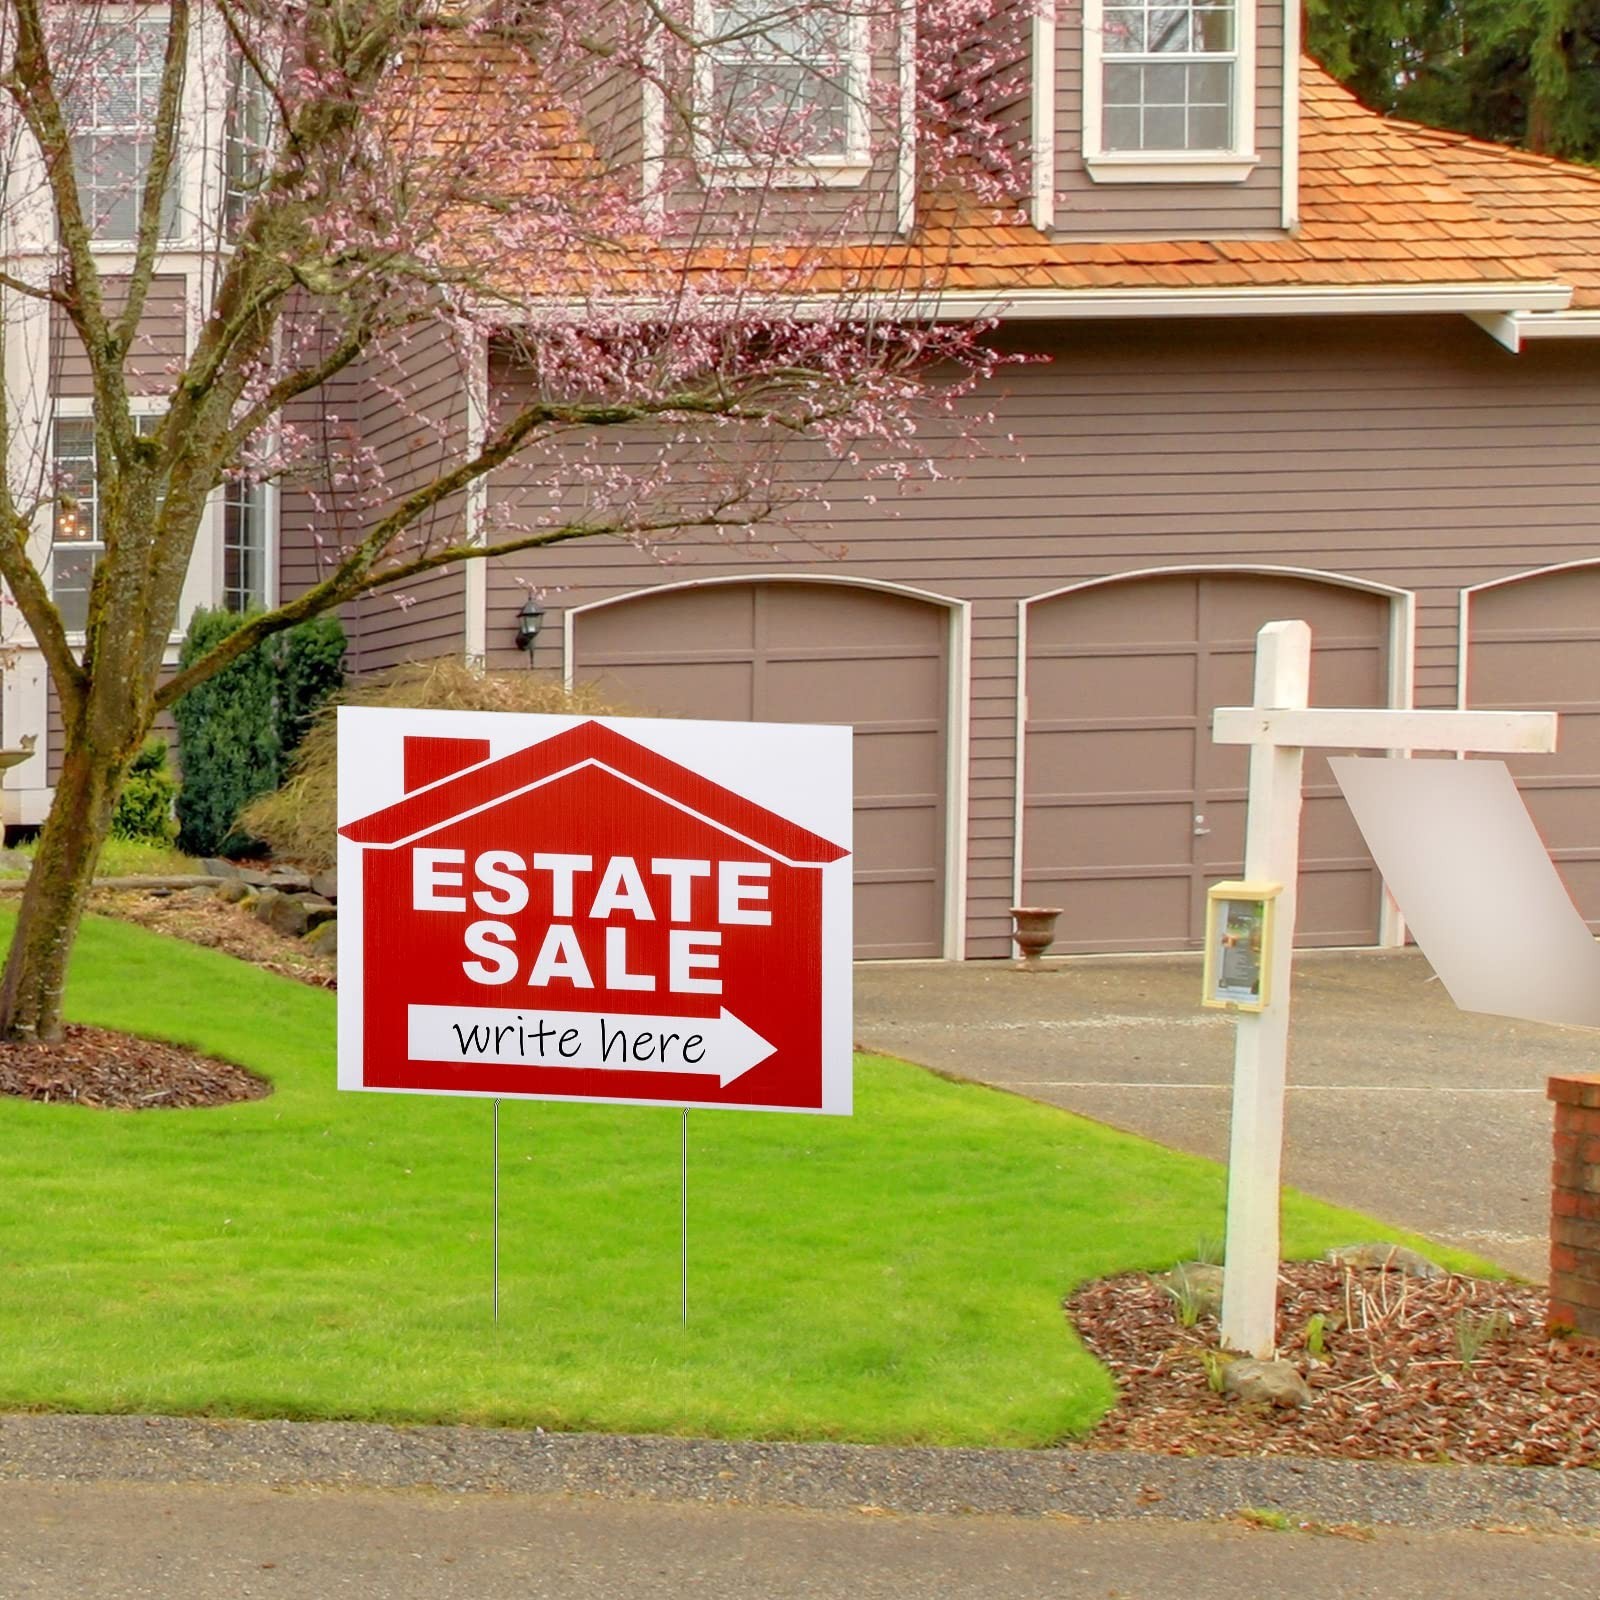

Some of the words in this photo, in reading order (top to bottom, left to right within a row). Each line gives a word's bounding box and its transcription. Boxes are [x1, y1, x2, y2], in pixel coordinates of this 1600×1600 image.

[413, 847, 772, 926] ESTATE
[462, 920, 723, 995] SALE
[452, 1015, 581, 1058] write
[600, 1018, 706, 1063] here
